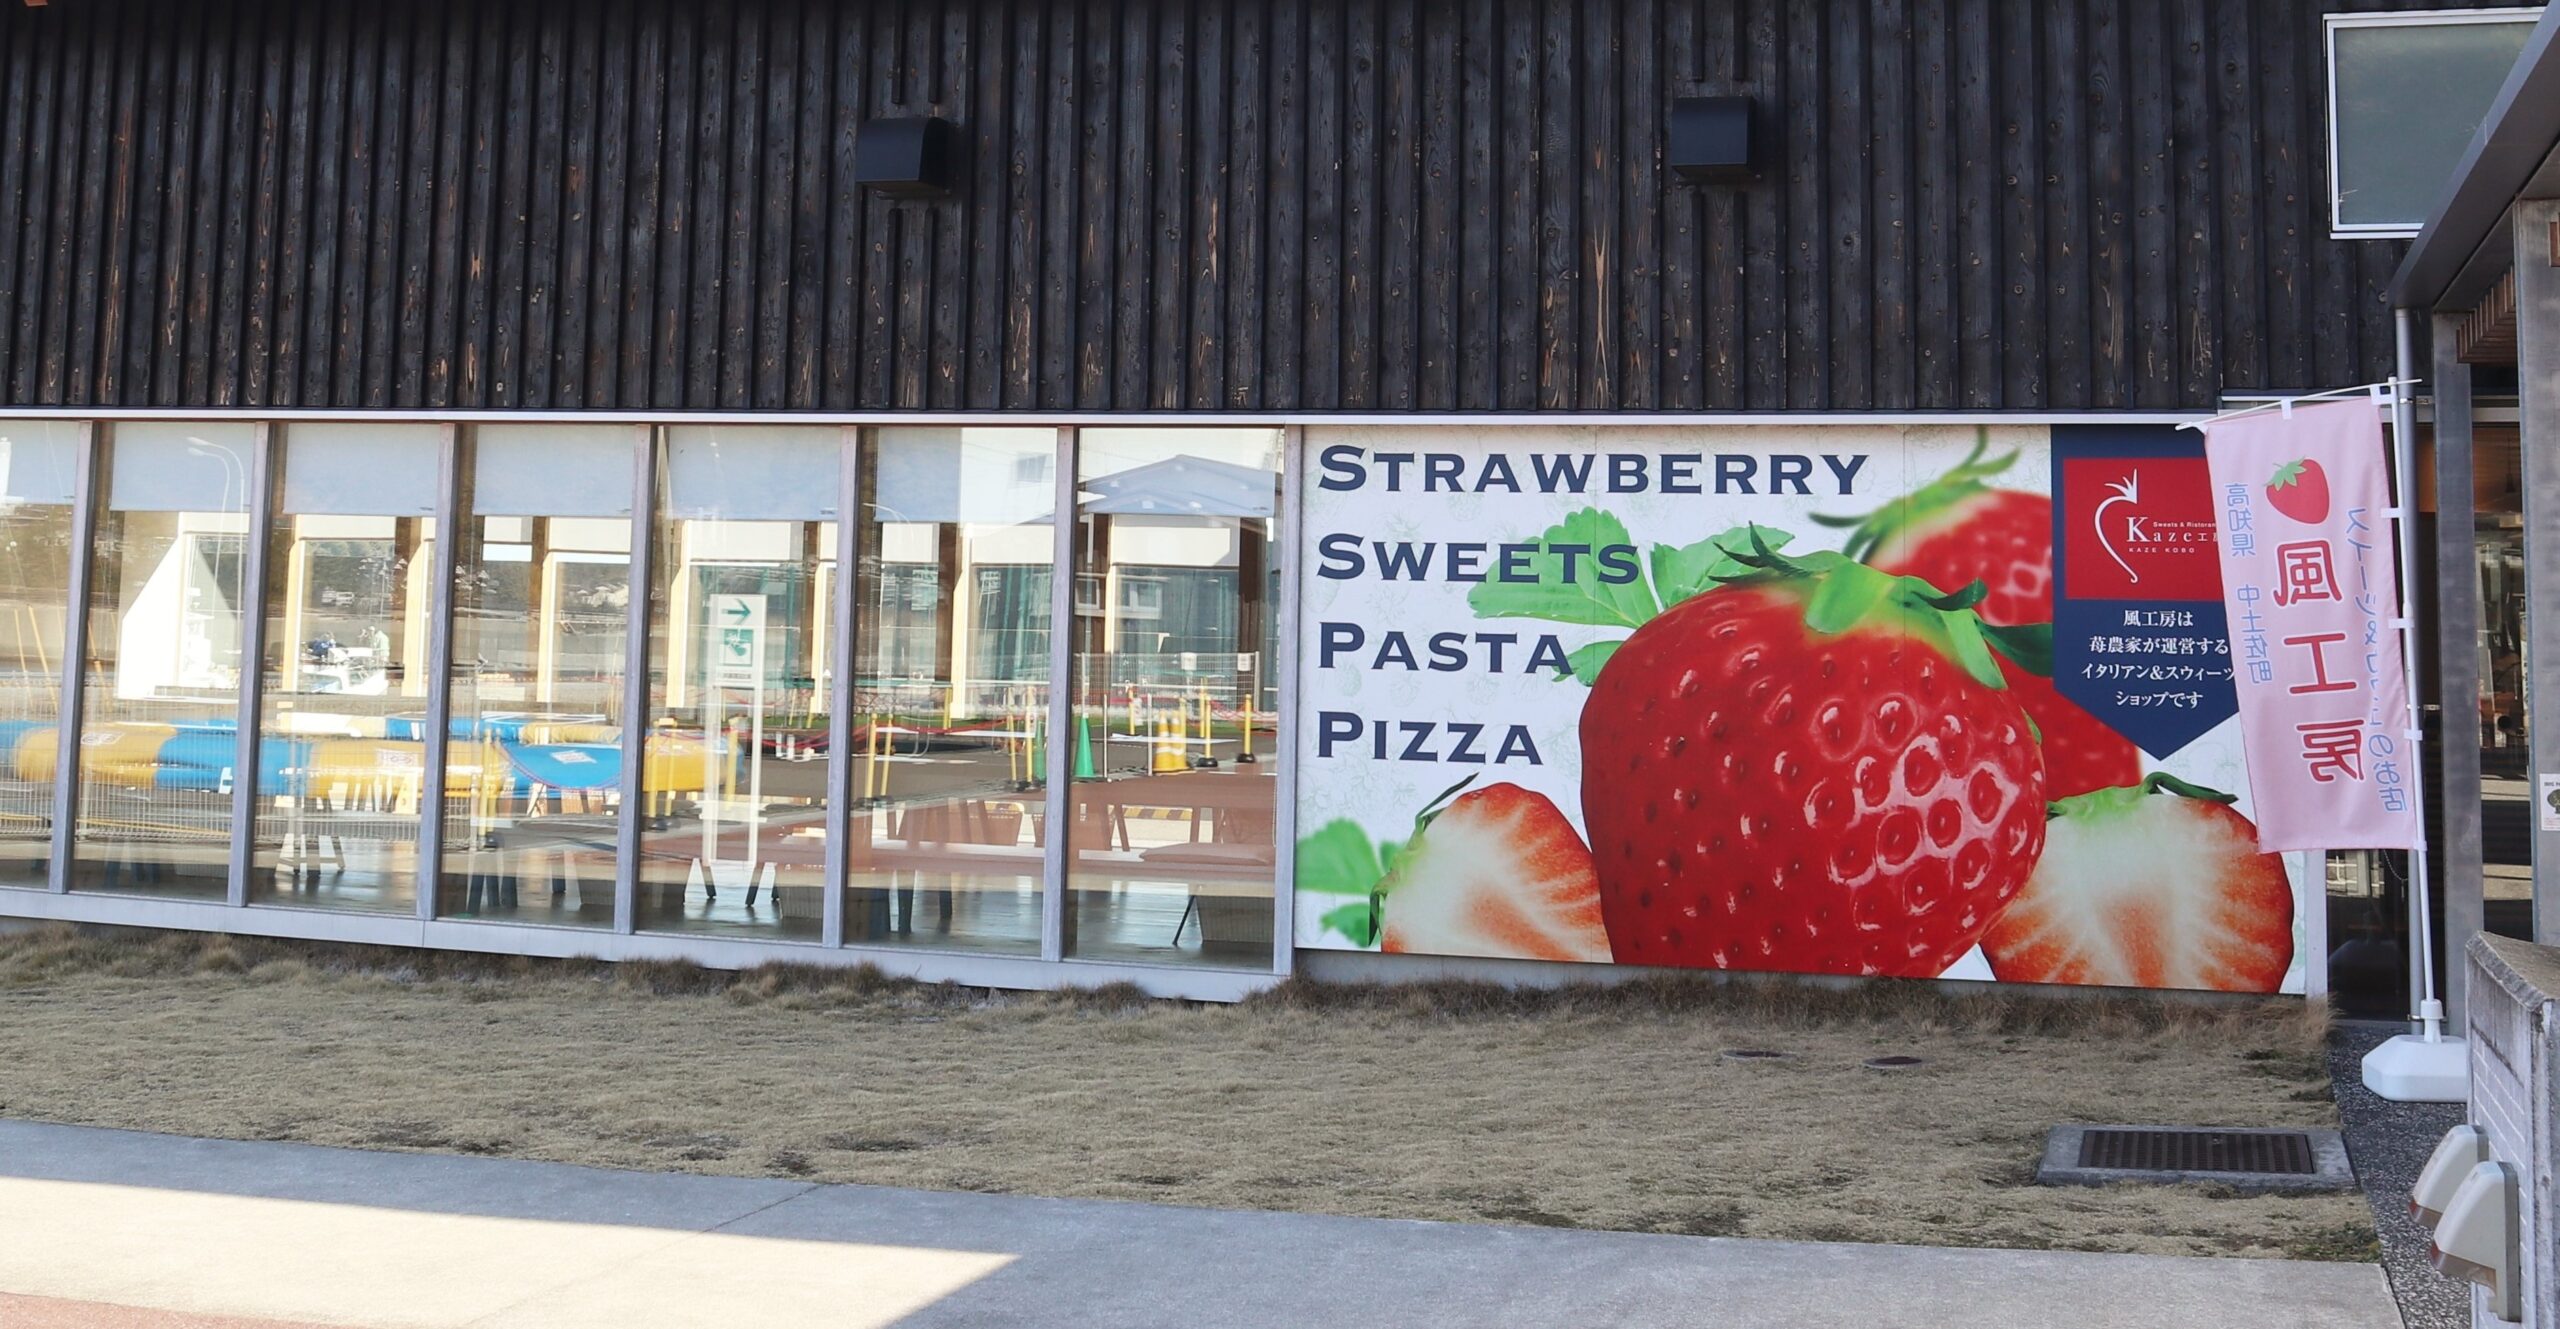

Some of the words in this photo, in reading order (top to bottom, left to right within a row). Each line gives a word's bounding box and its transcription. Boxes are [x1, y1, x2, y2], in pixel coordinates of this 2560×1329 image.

[1317, 444, 1869, 496] STRAWBERRY
[2126, 516, 2217, 543] Kaze工
[1316, 533, 1639, 585] SWEETS
[2123, 610, 2194, 628] 風工房は
[1318, 621, 1575, 675] PASTA
[2088, 635, 2229, 655] 苺農家が運営する
[2081, 662, 2235, 681] イタリアン&スウィーツ
[2115, 690, 2204, 709] ショップです
[1317, 710, 1544, 766] PIZZA
